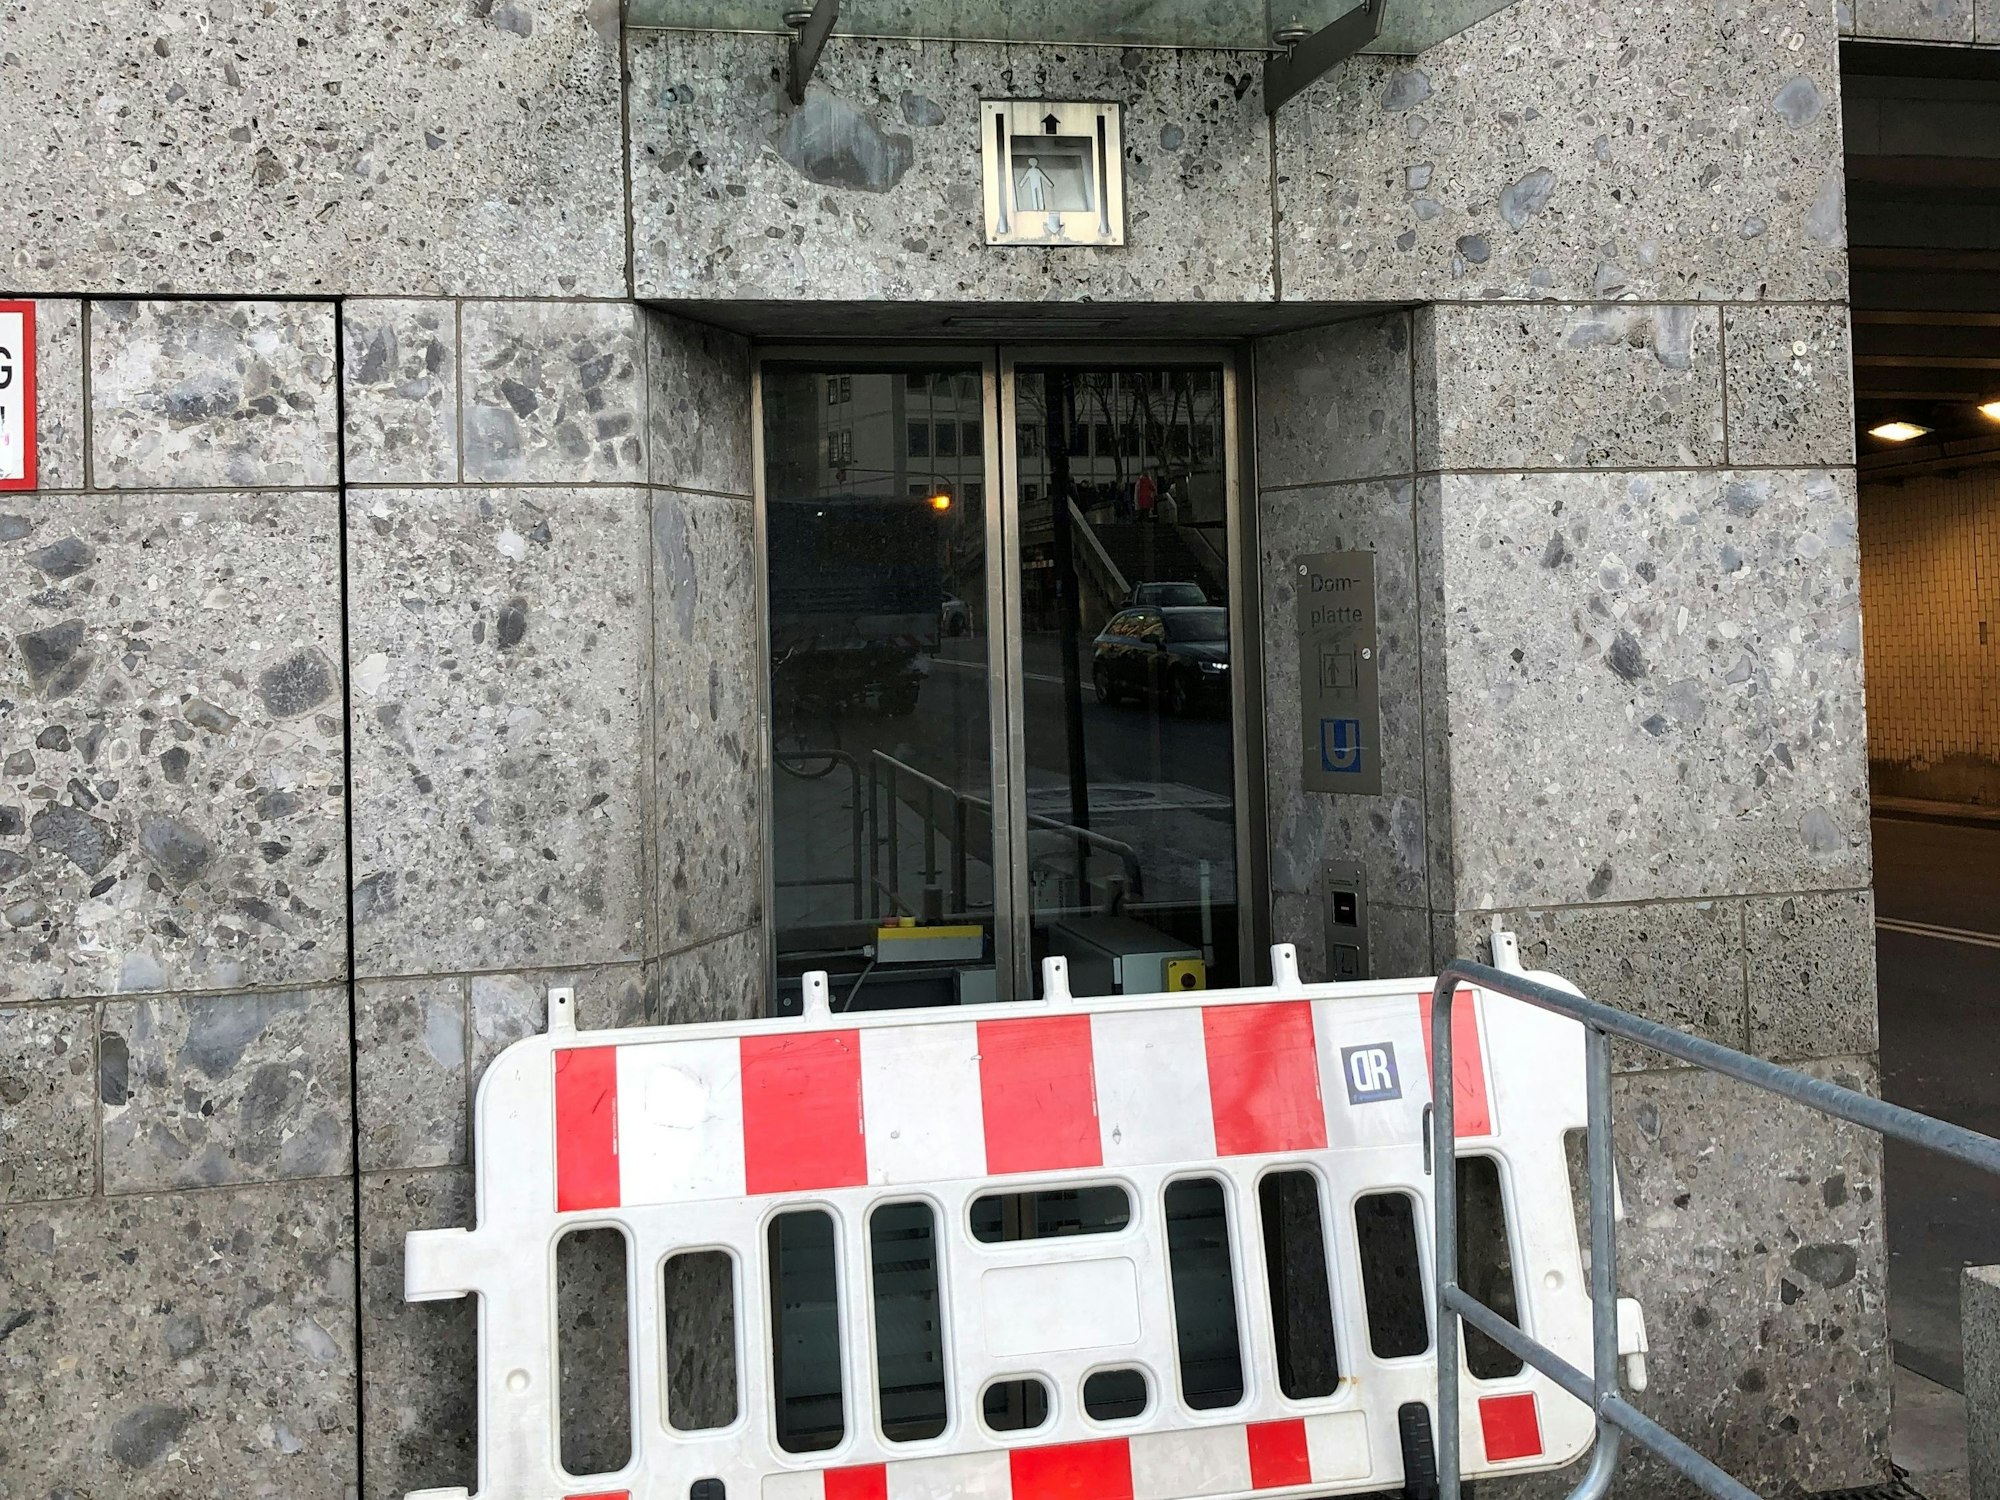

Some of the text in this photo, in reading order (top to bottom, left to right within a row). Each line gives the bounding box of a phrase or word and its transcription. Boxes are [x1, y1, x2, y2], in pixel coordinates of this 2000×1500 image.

[1310, 573, 1361, 593] Dom-
[1311, 604, 1363, 628] platte
[1324, 722, 1357, 768] U
